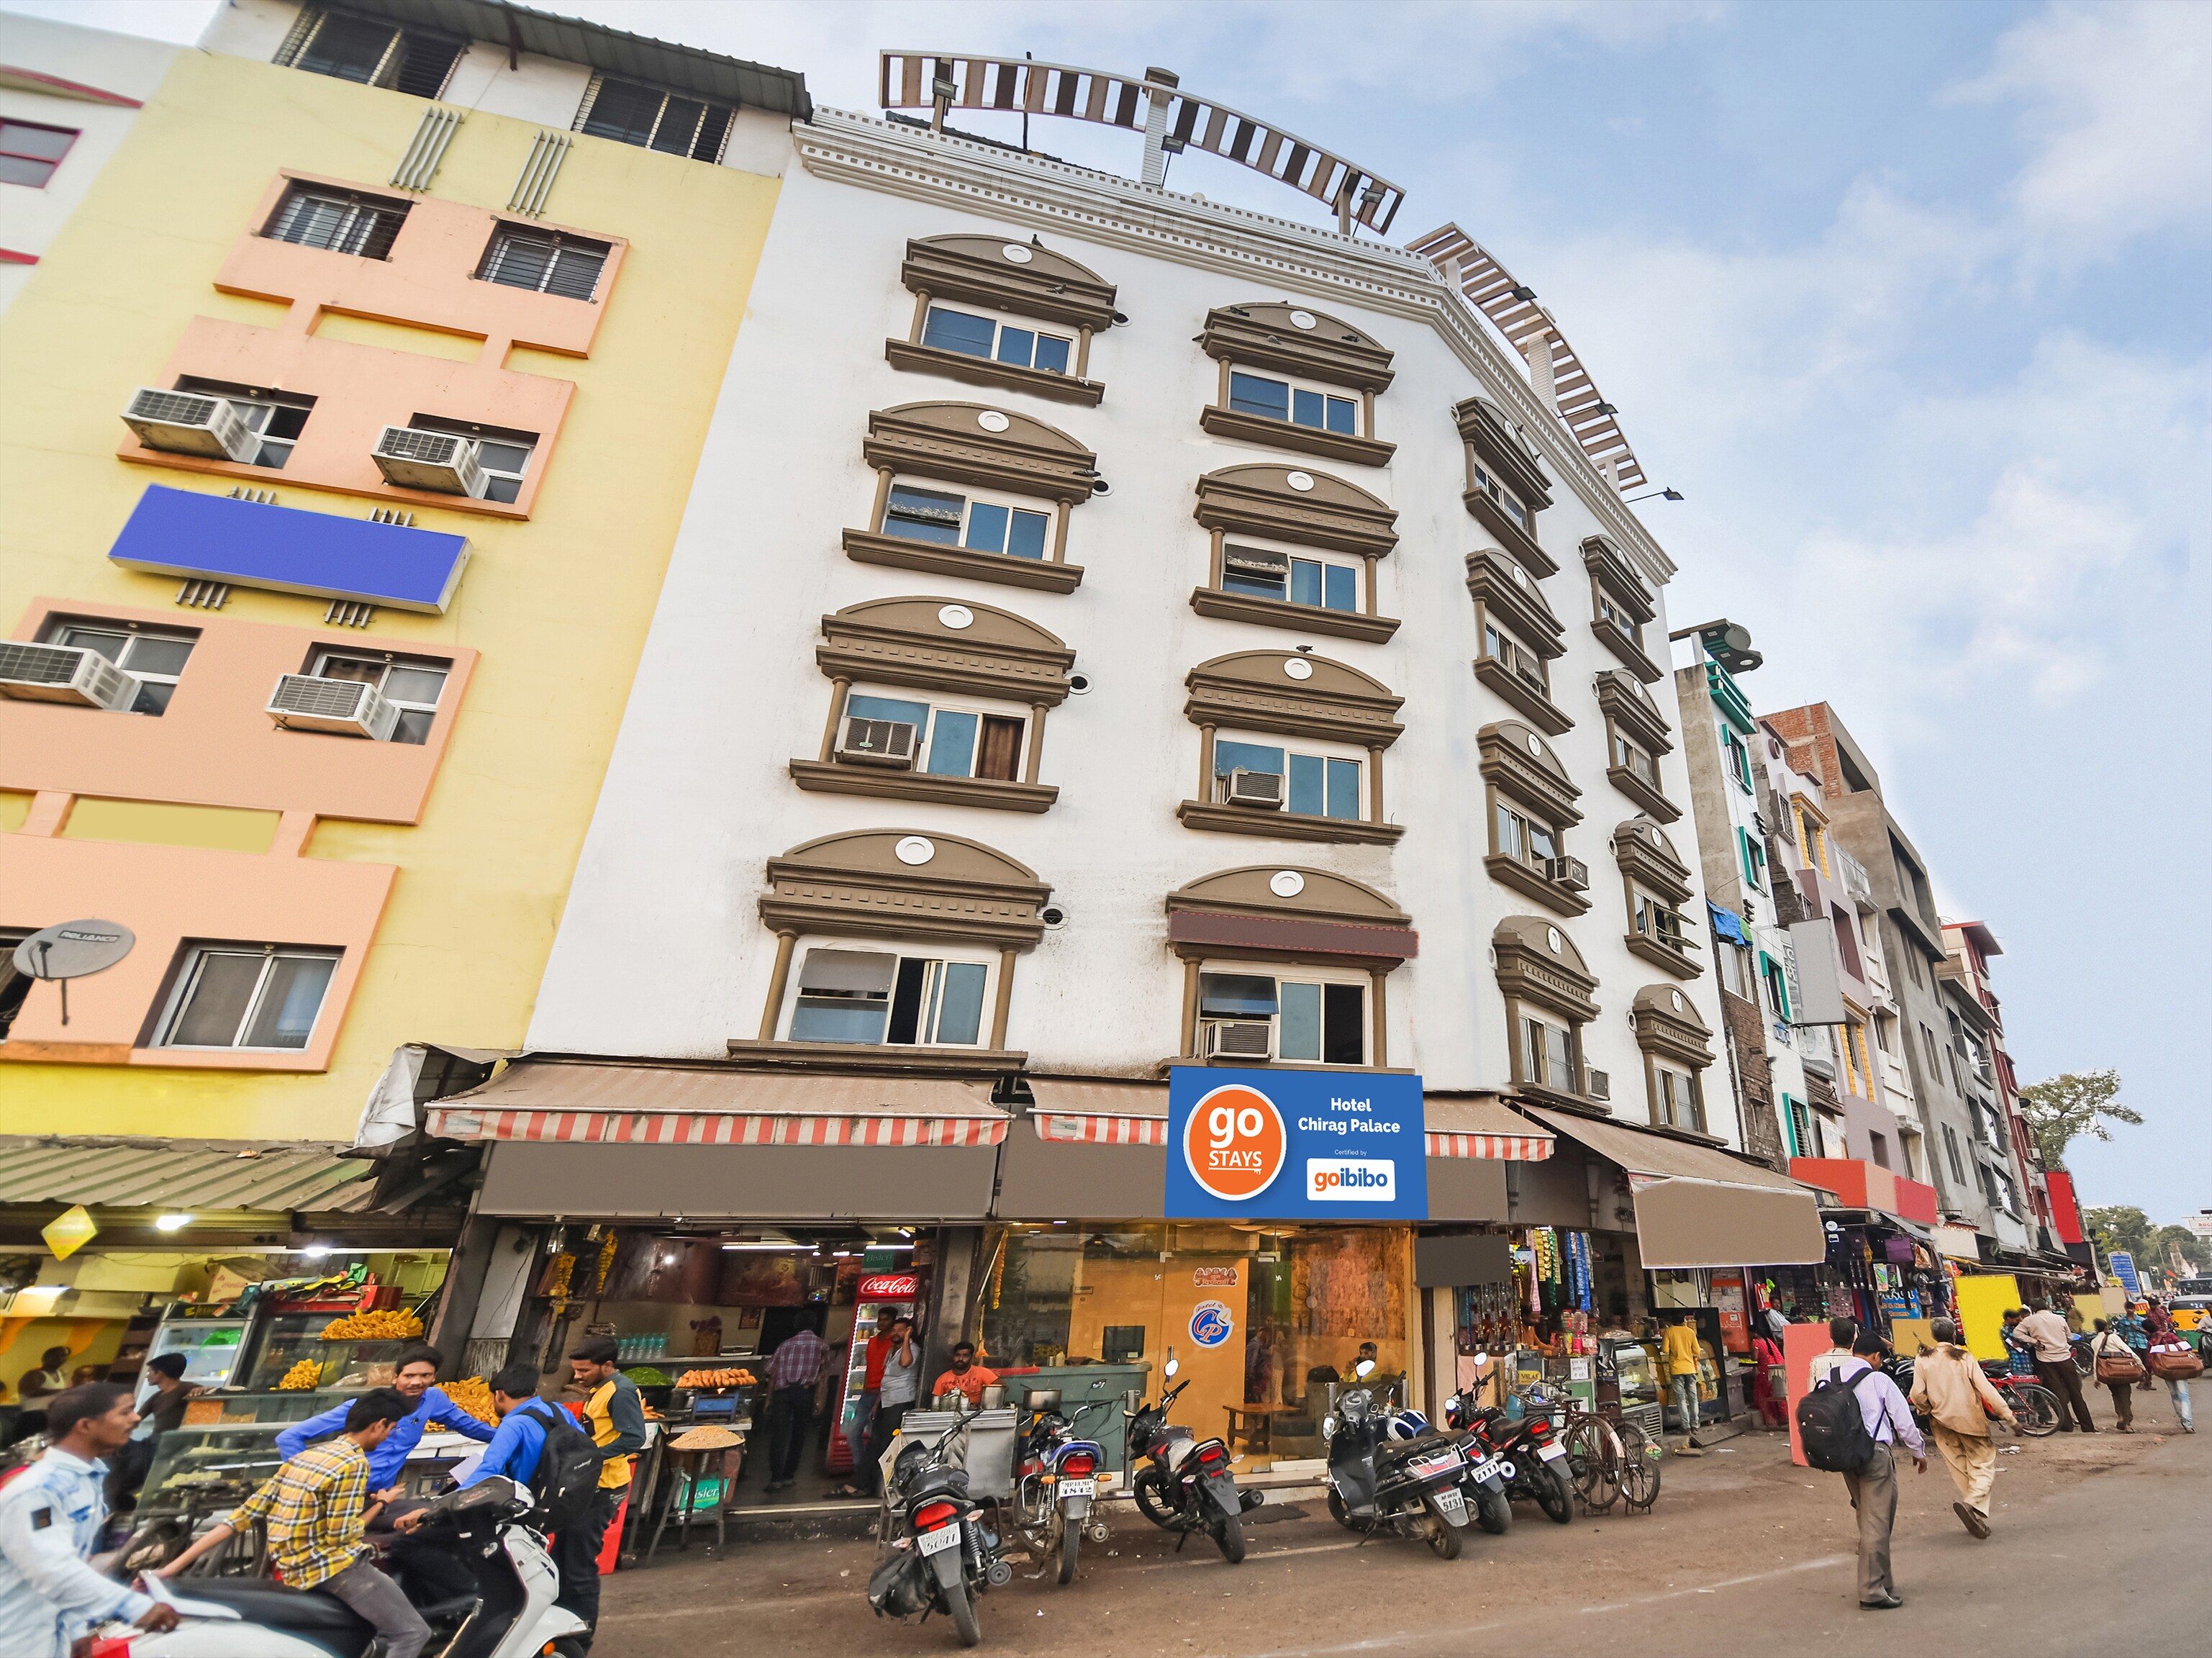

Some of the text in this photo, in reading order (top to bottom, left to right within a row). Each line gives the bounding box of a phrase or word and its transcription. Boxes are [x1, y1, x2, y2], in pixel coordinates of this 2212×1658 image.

[60, 930, 118, 943] RELIANCE
[1331, 1097, 1372, 1113] Hotel
[1208, 1106, 1264, 1149] go
[1297, 1116, 1401, 1136] Chirag Palace
[1209, 1149, 1262, 1167] STAYS
[1314, 1168, 1388, 1192] goibibo
[860, 1277, 918, 1295] Coca-Cola
[1443, 1497, 1462, 1511] 5131
[925, 1533, 956, 1551] 5041
